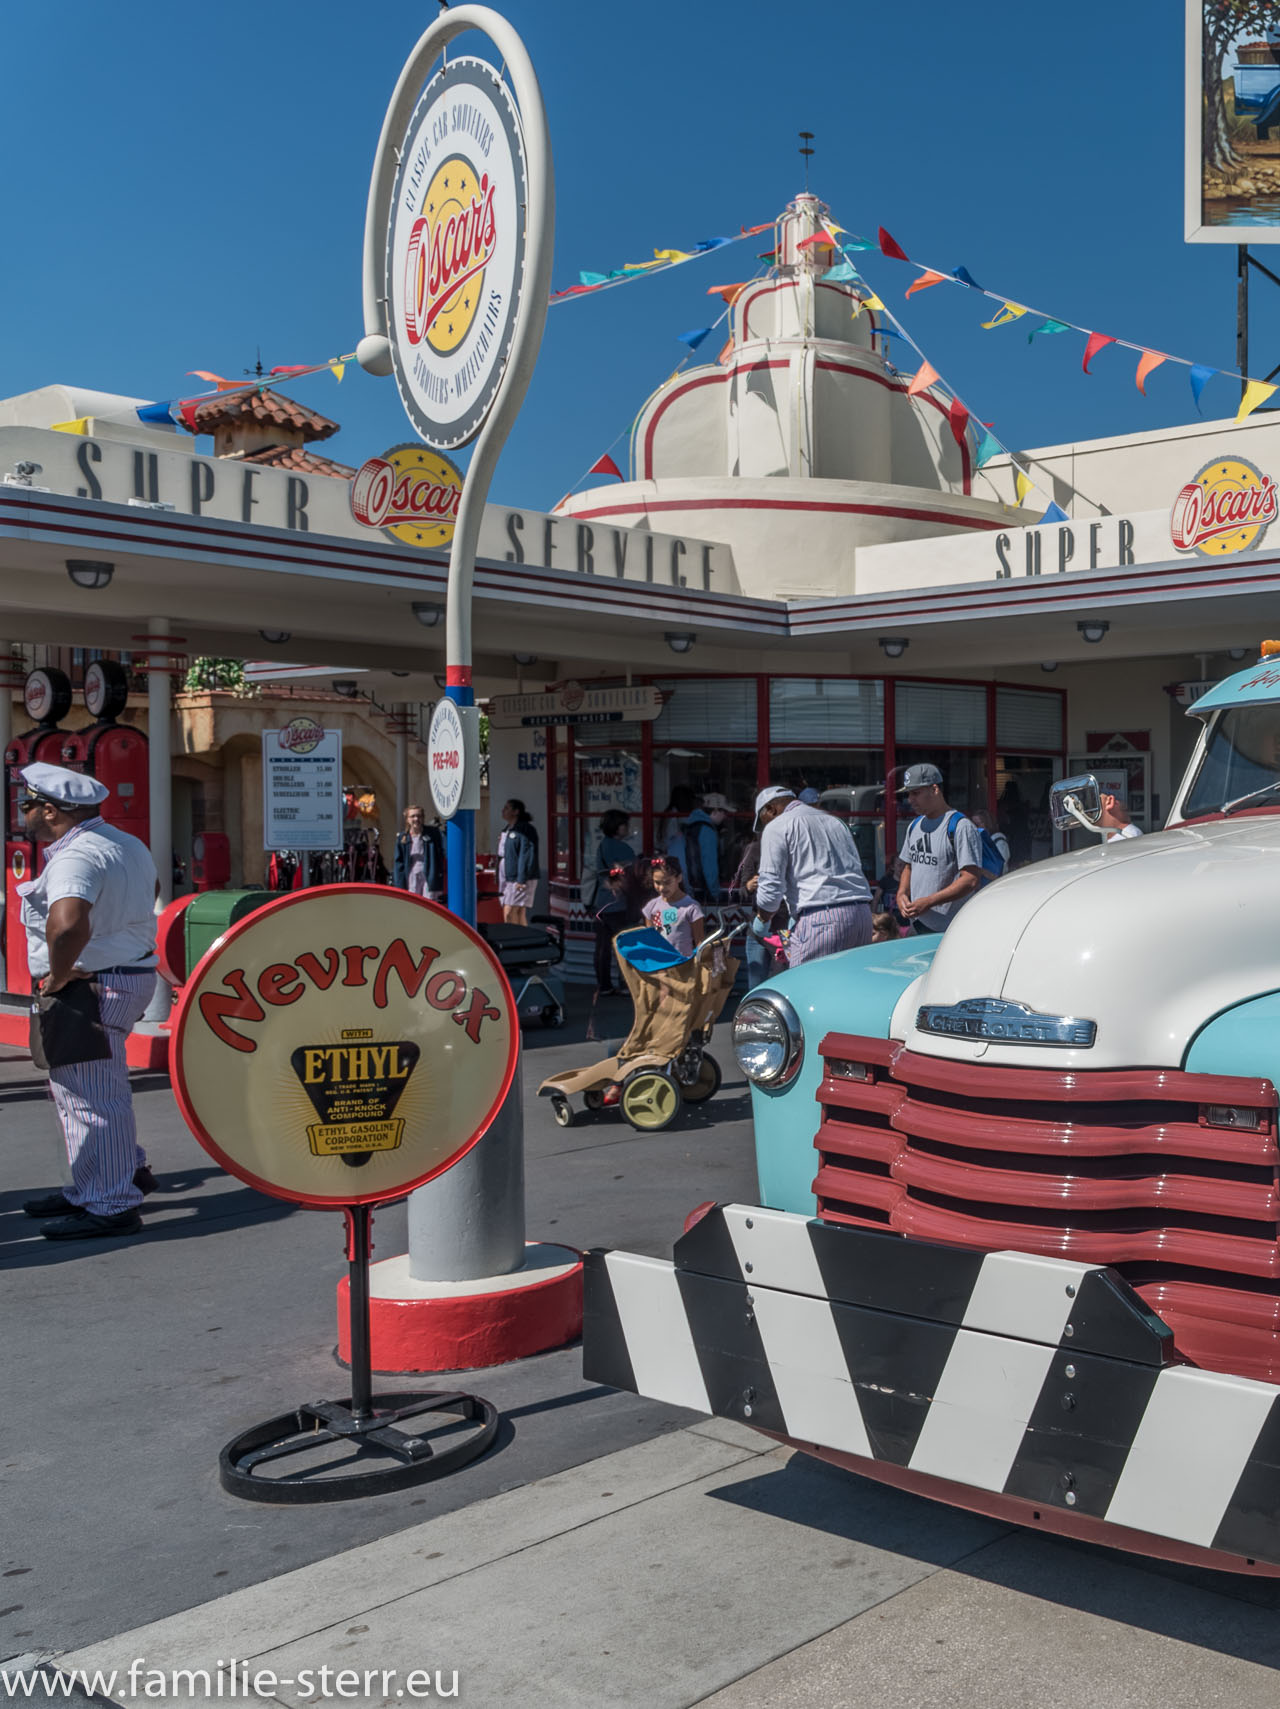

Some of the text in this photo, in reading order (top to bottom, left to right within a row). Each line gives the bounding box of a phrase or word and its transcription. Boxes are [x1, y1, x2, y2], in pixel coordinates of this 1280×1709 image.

[405, 103, 495, 213] CLASSIC CAR SOUVENIRS
[405, 172, 497, 346] Oscar's
[413, 289, 503, 405] STROLLERS WHEELCHAIRS
[76, 441, 717, 592] SUPER Oscar SERVICE
[995, 519, 1136, 579] SUPER
[1171, 474, 1279, 552] Oscar's
[432, 750, 460, 771] PRE-PAID
[518, 753, 547, 770] ELEC
[583, 771, 624, 786] ENTRANCE
[909, 850, 939, 867] didas
[198, 938, 501, 1053] NevrNox
[346, 1030, 369, 1038] WITH
[930, 1014, 1052, 1041] CHEVROLET
[304, 1045, 409, 1084] ETHYL
[334, 1098, 364, 1107] BRAND
[330, 1111, 384, 1121] COMPOUND
[318, 1122, 395, 1137] ETHYL GASOLINE
[325, 1133, 389, 1146] CORPORATION
